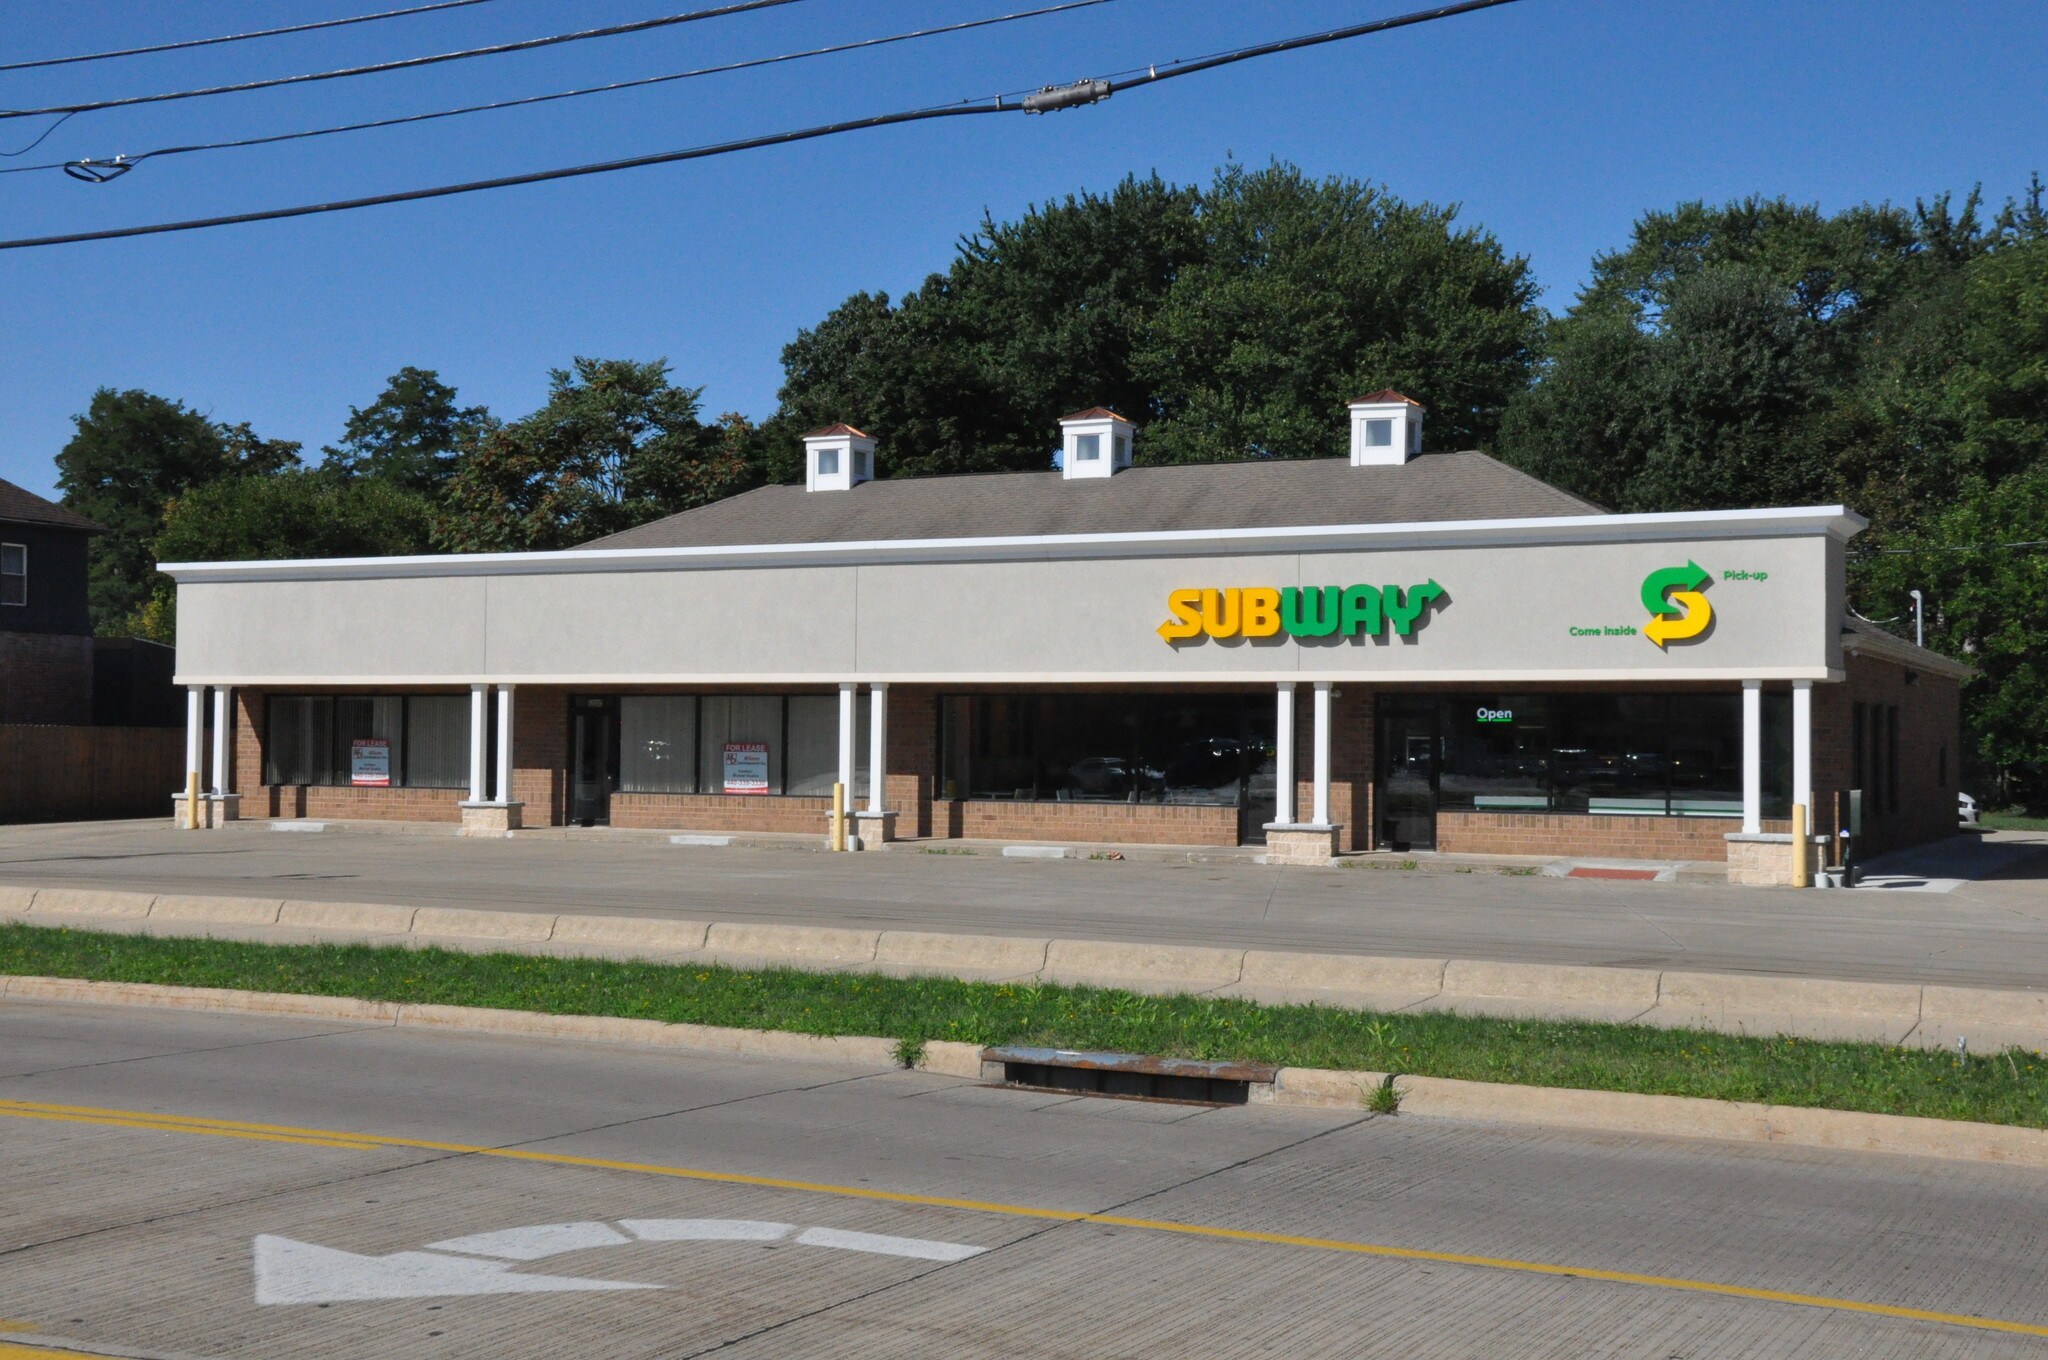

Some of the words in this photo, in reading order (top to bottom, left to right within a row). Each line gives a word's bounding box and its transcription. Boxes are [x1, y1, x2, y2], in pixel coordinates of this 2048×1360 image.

[1723, 570, 1768, 582] Pick-up
[1156, 578, 1445, 643] SUBWAY
[1569, 626, 1601, 637] Come
[1477, 707, 1513, 722] Open
[725, 744, 740, 752] FOR
[742, 744, 765, 752] LEASE
